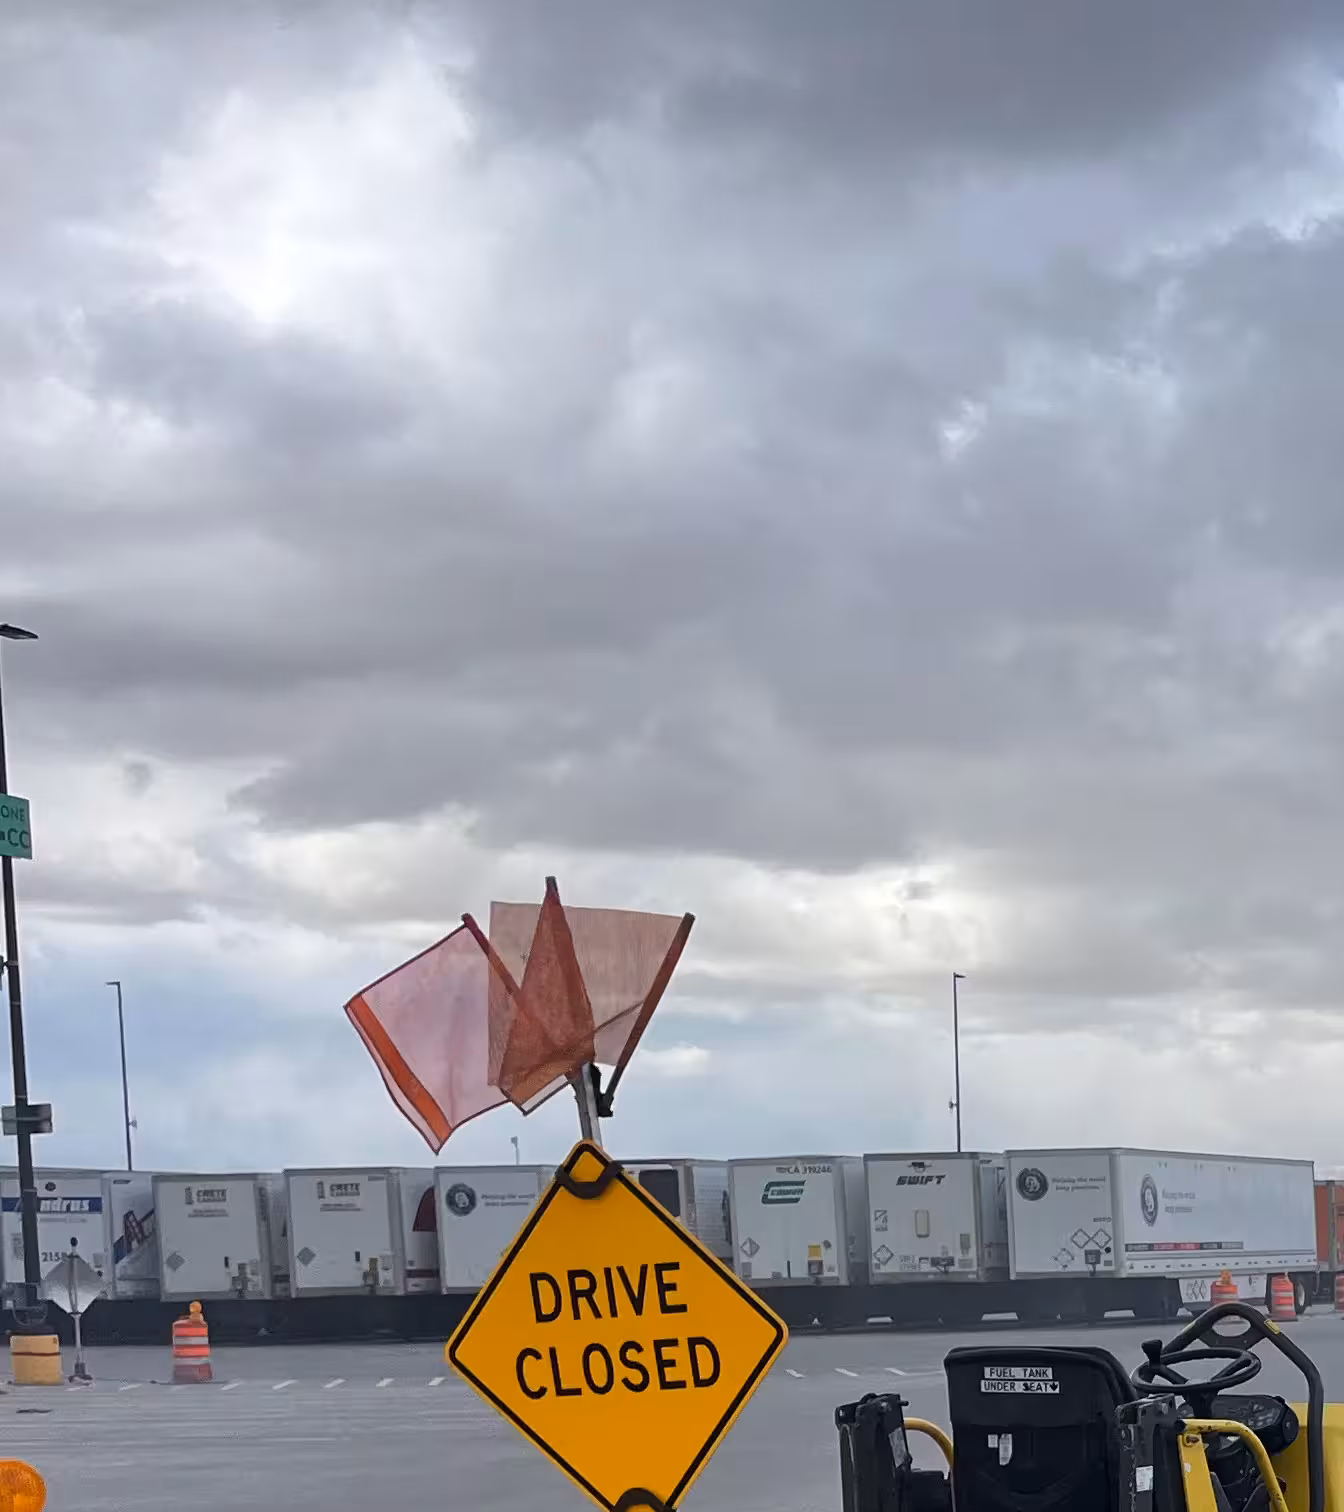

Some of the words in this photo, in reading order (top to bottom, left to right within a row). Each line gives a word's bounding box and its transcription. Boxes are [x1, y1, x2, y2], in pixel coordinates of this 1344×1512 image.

[0, 804, 25, 822] ONE
[896, 1174, 947, 1186] SWIFT
[529, 1262, 688, 1323] DRIVE
[516, 1336, 721, 1399] CLOSED
[990, 1367, 1016, 1378] FUEL
[1023, 1368, 1049, 1378] TANK
[984, 1381, 1016, 1392] UNDER
[1022, 1382, 1050, 1393] SEAT
